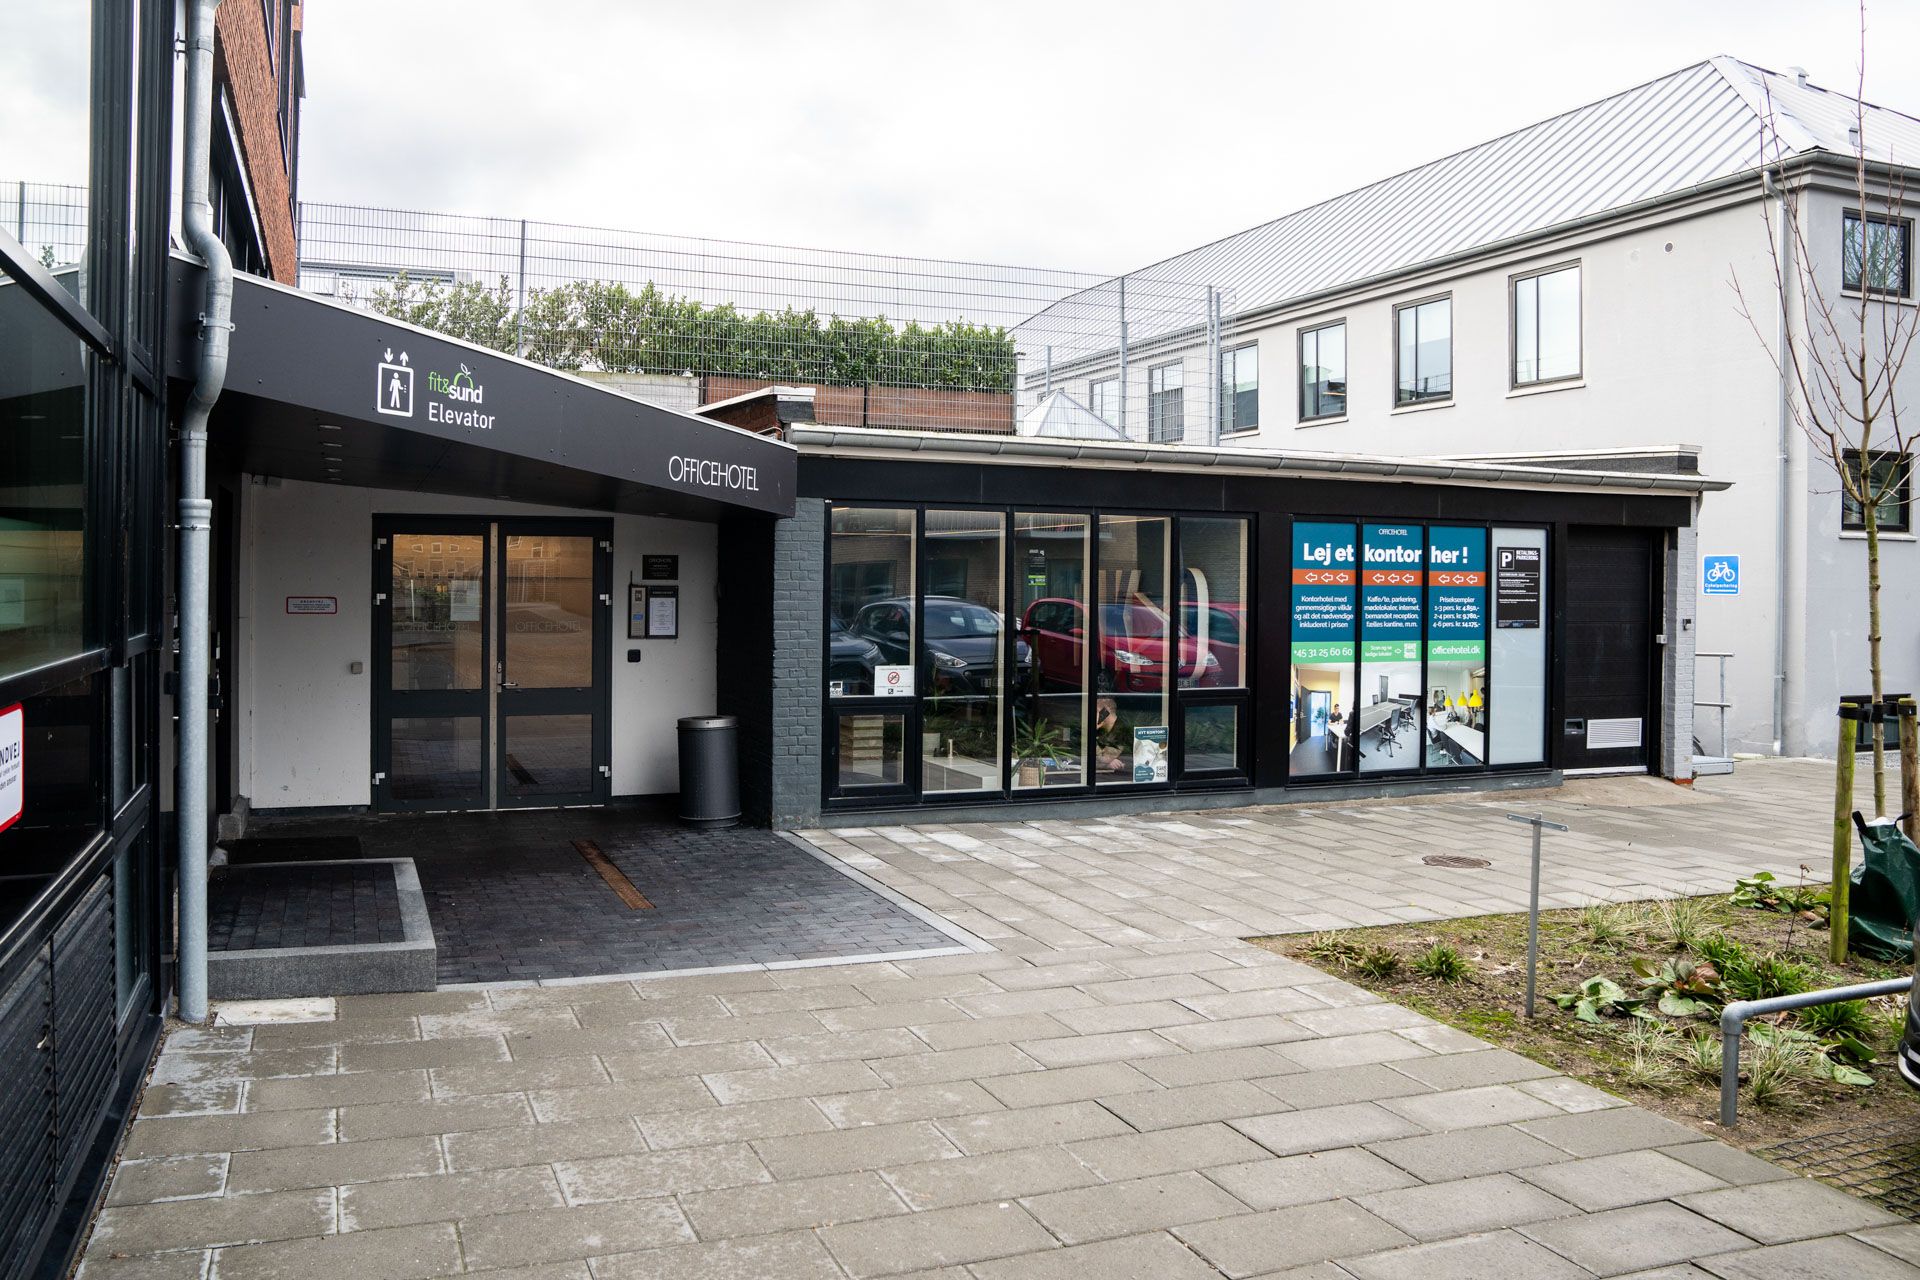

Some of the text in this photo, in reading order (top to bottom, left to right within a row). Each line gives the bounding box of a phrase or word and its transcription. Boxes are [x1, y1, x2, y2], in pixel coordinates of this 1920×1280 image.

[428, 401, 496, 430] Elevator
[668, 455, 760, 491] OFFICEHOTEL
[1378, 528, 1408, 536] OFFICEHOTEL
[1303, 543, 1332, 566] Lej
[1334, 544, 1355, 562] et
[1364, 544, 1423, 563] kontor
[1430, 546, 1460, 563] her
[1501, 552, 1513, 567] P
[1439, 596, 1476, 604] Priseksempler
[1321, 613, 1354, 621] nødvendige
[1331, 621, 1349, 629] prisen
[1318, 648, 1329, 658] 25
[1329, 647, 1341, 657] 60
[1341, 647, 1353, 656] 60
[1431, 645, 1481, 655] officehotel.dk
